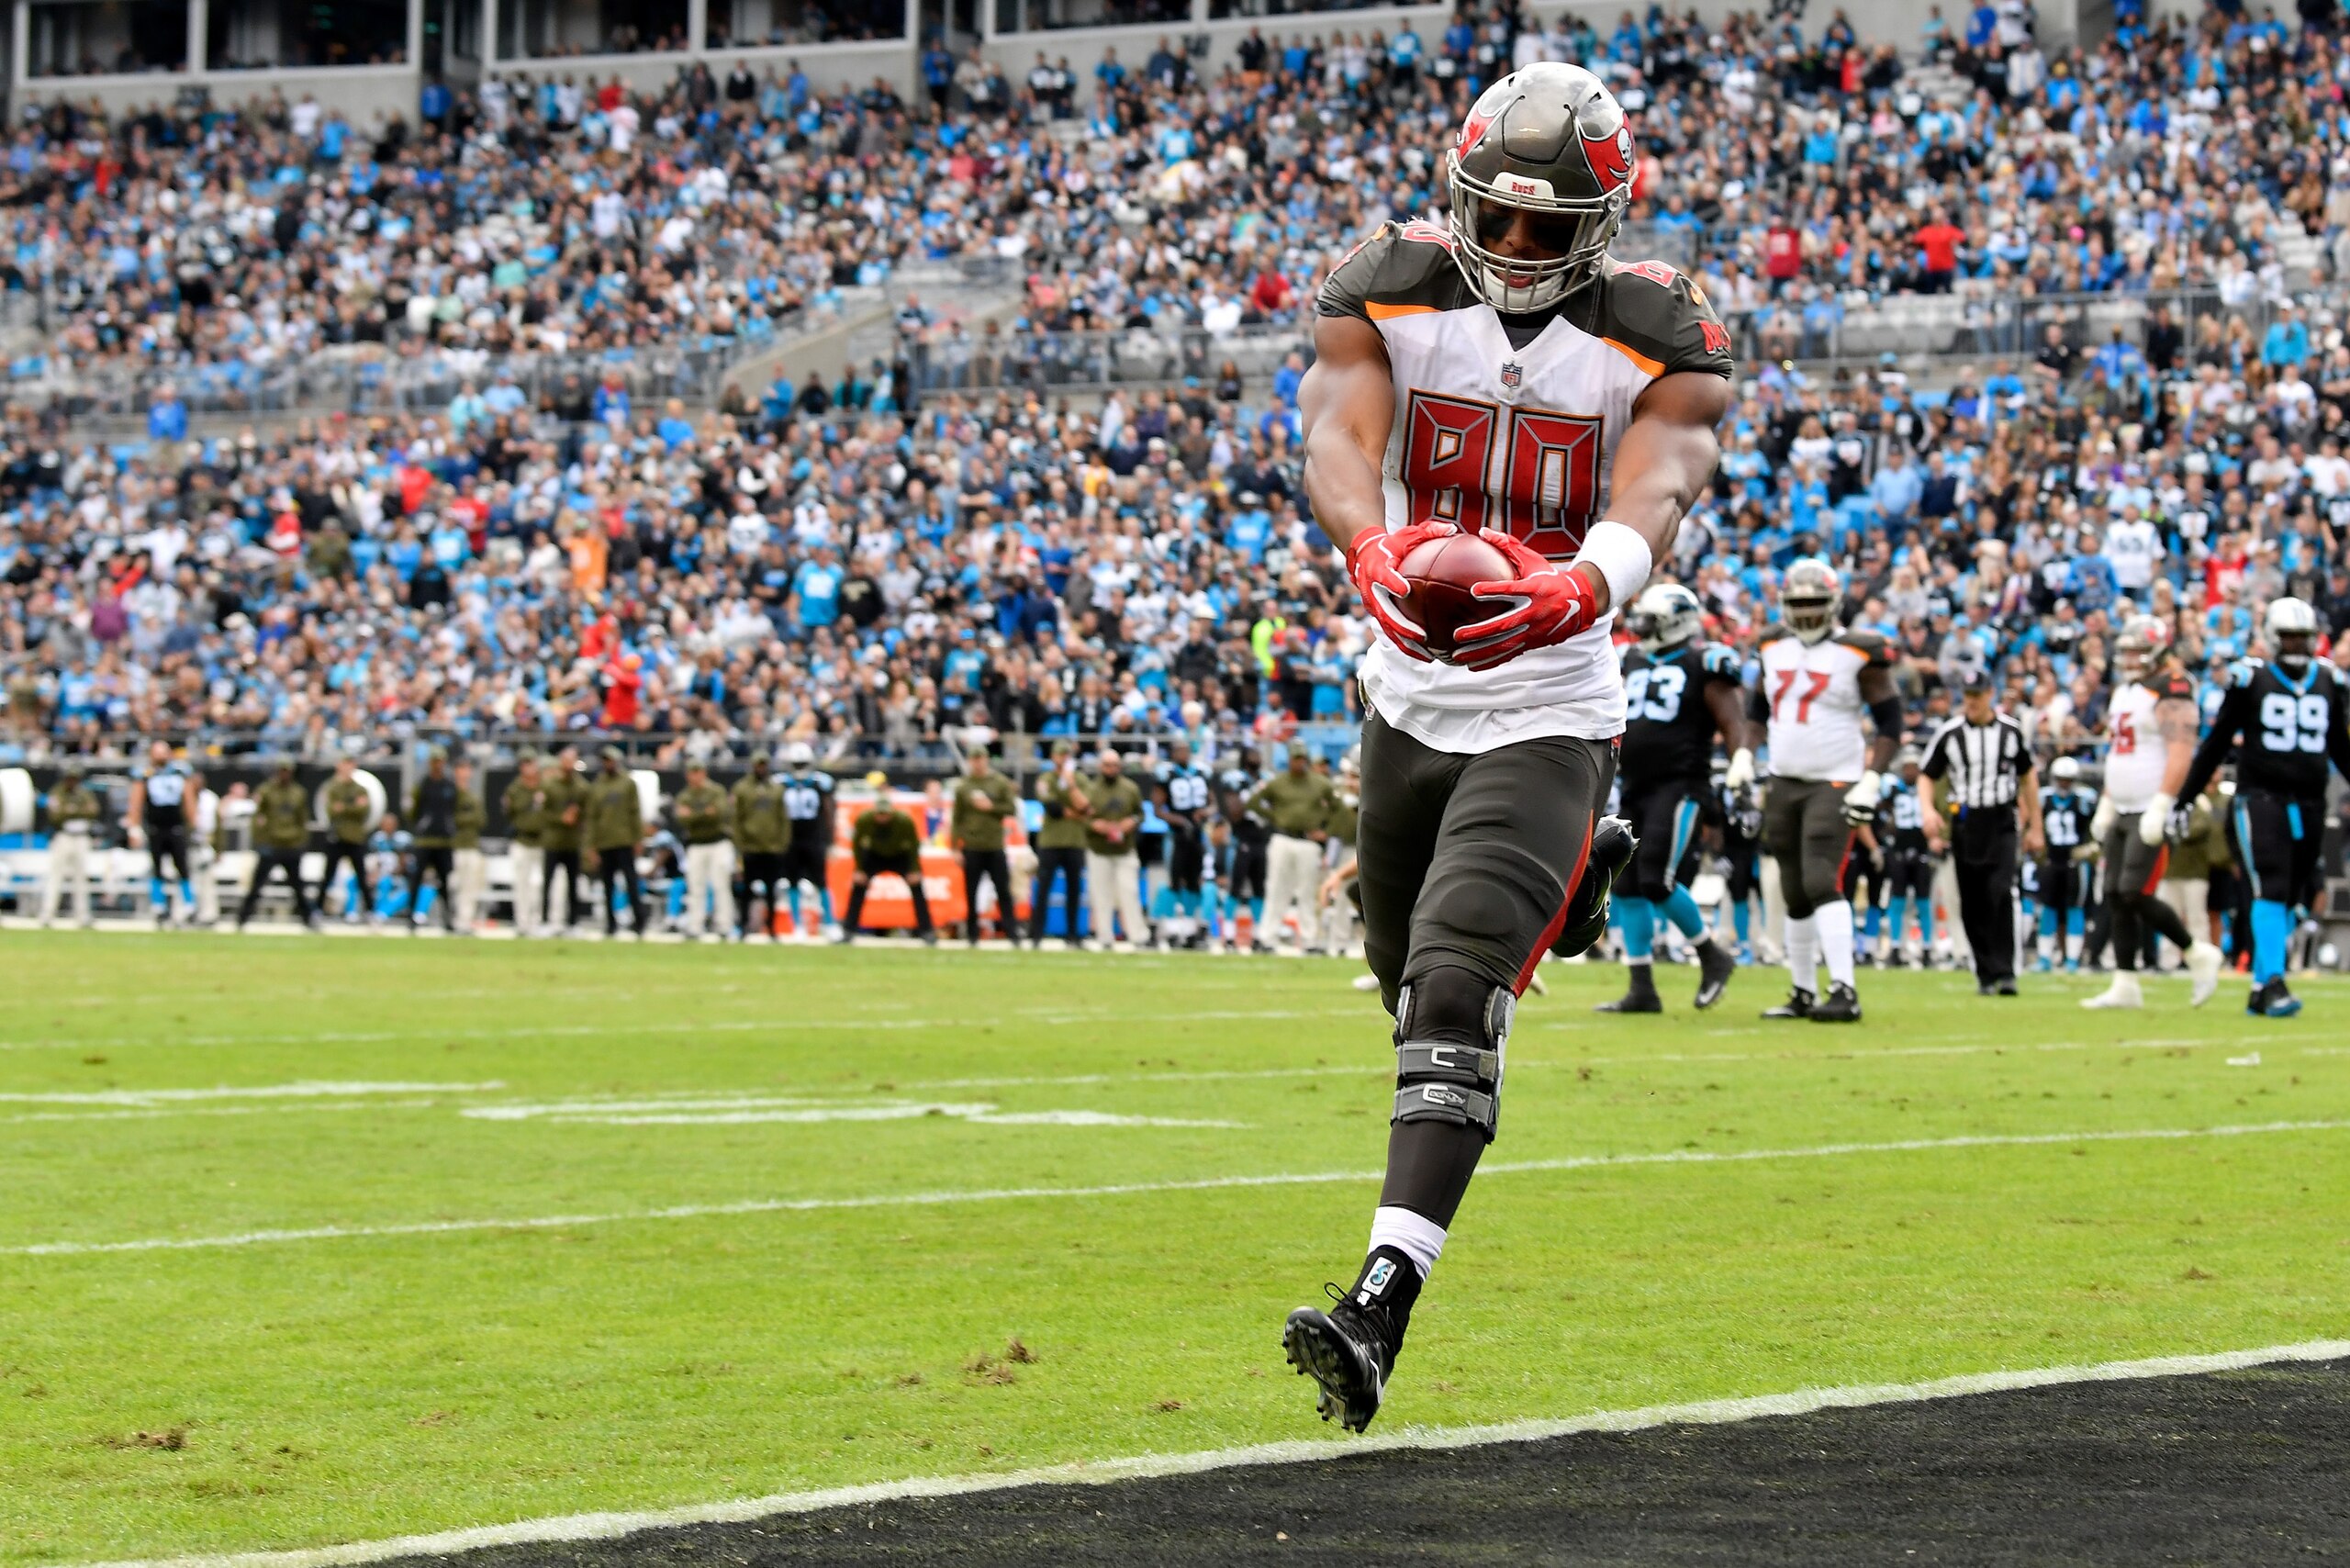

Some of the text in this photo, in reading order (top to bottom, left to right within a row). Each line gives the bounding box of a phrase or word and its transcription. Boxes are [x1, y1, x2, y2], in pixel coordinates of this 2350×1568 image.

[1511, 181, 1536, 196] BUCS
[1401, 387, 1604, 562] 80
[1624, 665, 1687, 722] 93
[1772, 669, 1830, 724] 77
[2261, 691, 2329, 754] 99
[2045, 809, 2079, 846] 41
